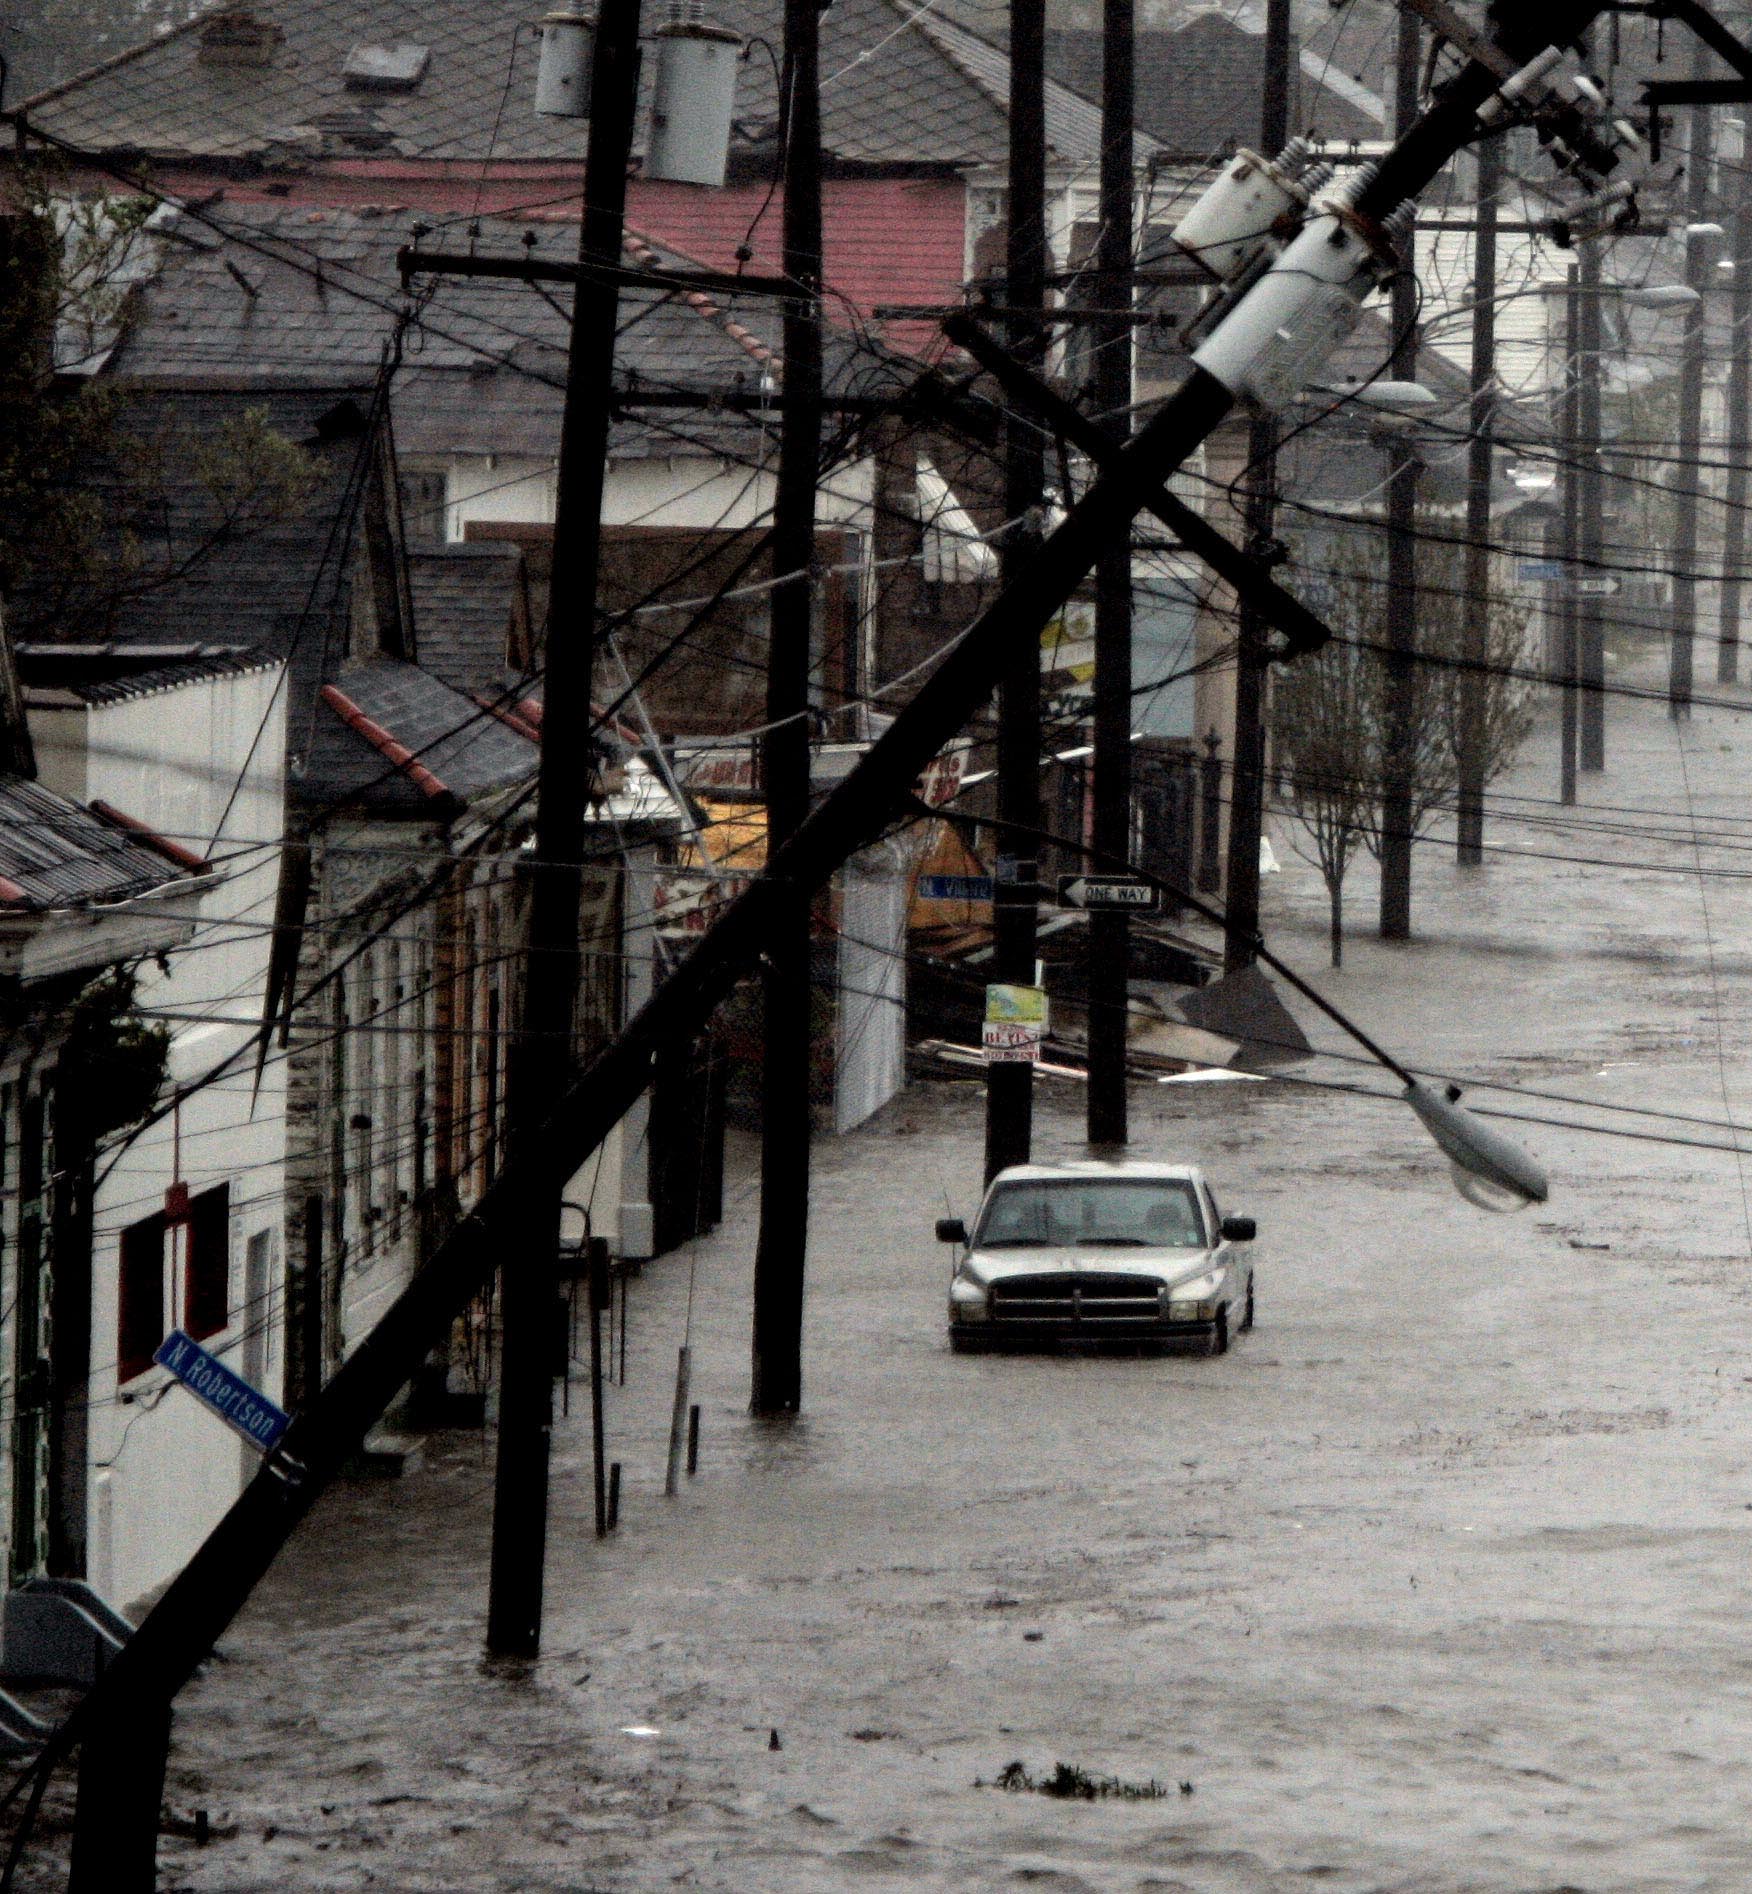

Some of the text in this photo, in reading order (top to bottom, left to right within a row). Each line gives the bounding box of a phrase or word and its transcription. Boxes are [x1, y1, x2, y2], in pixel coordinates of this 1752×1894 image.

[1086, 885, 1147, 901] ONE WAY
[186, 1357, 275, 1438] Robertson
